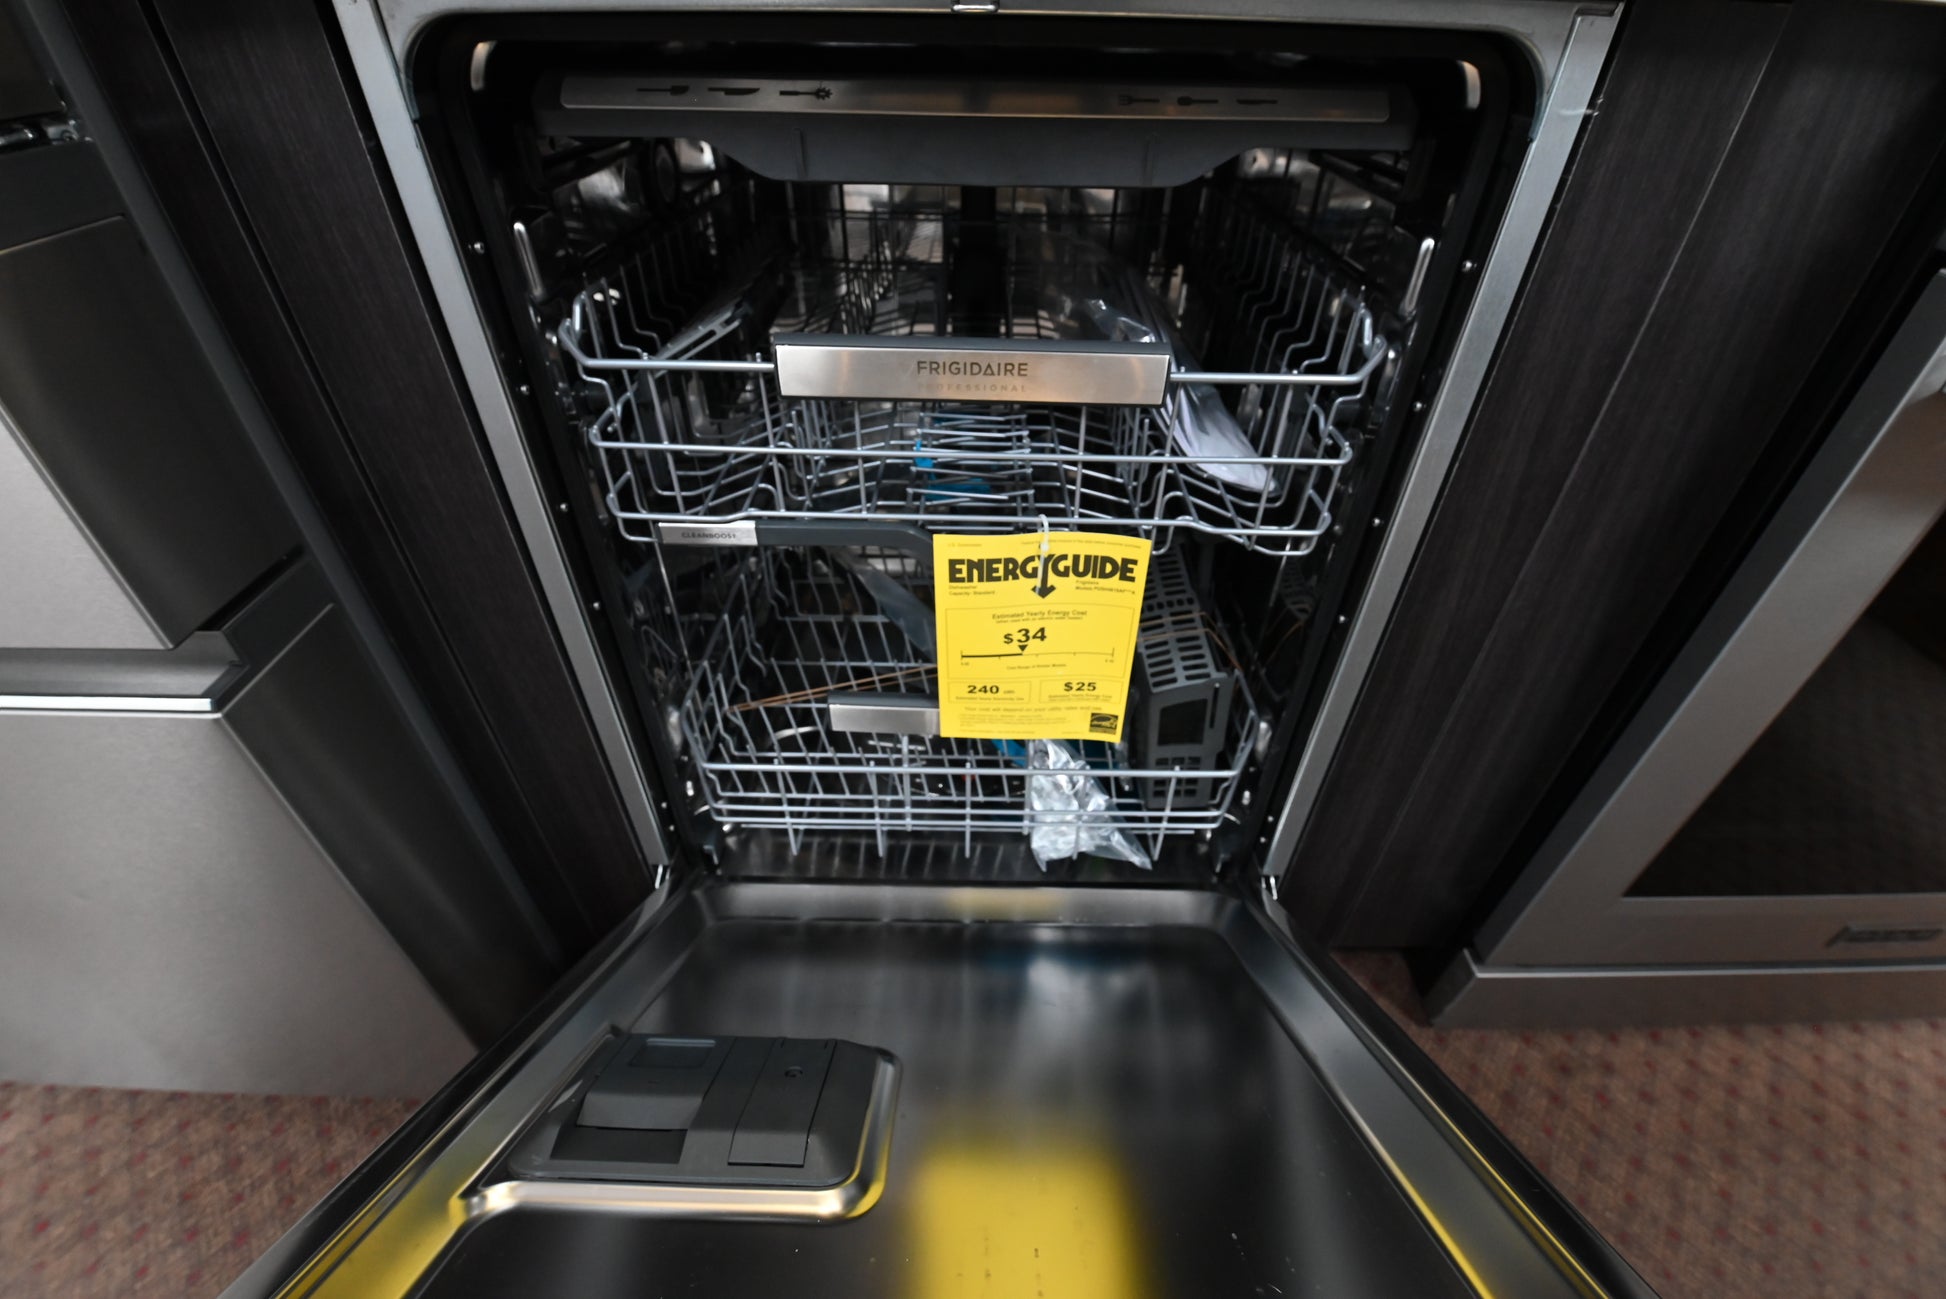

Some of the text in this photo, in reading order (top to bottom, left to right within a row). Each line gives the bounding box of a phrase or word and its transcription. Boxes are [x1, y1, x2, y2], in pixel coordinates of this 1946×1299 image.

[917, 361, 1028, 376] FRIGIDAIRE
[918, 383, 1026, 392] OFESSIONAL
[1003, 627, 1047, 644] $34
[967, 685, 999, 694] 240
[1064, 682, 1096, 691] $25
